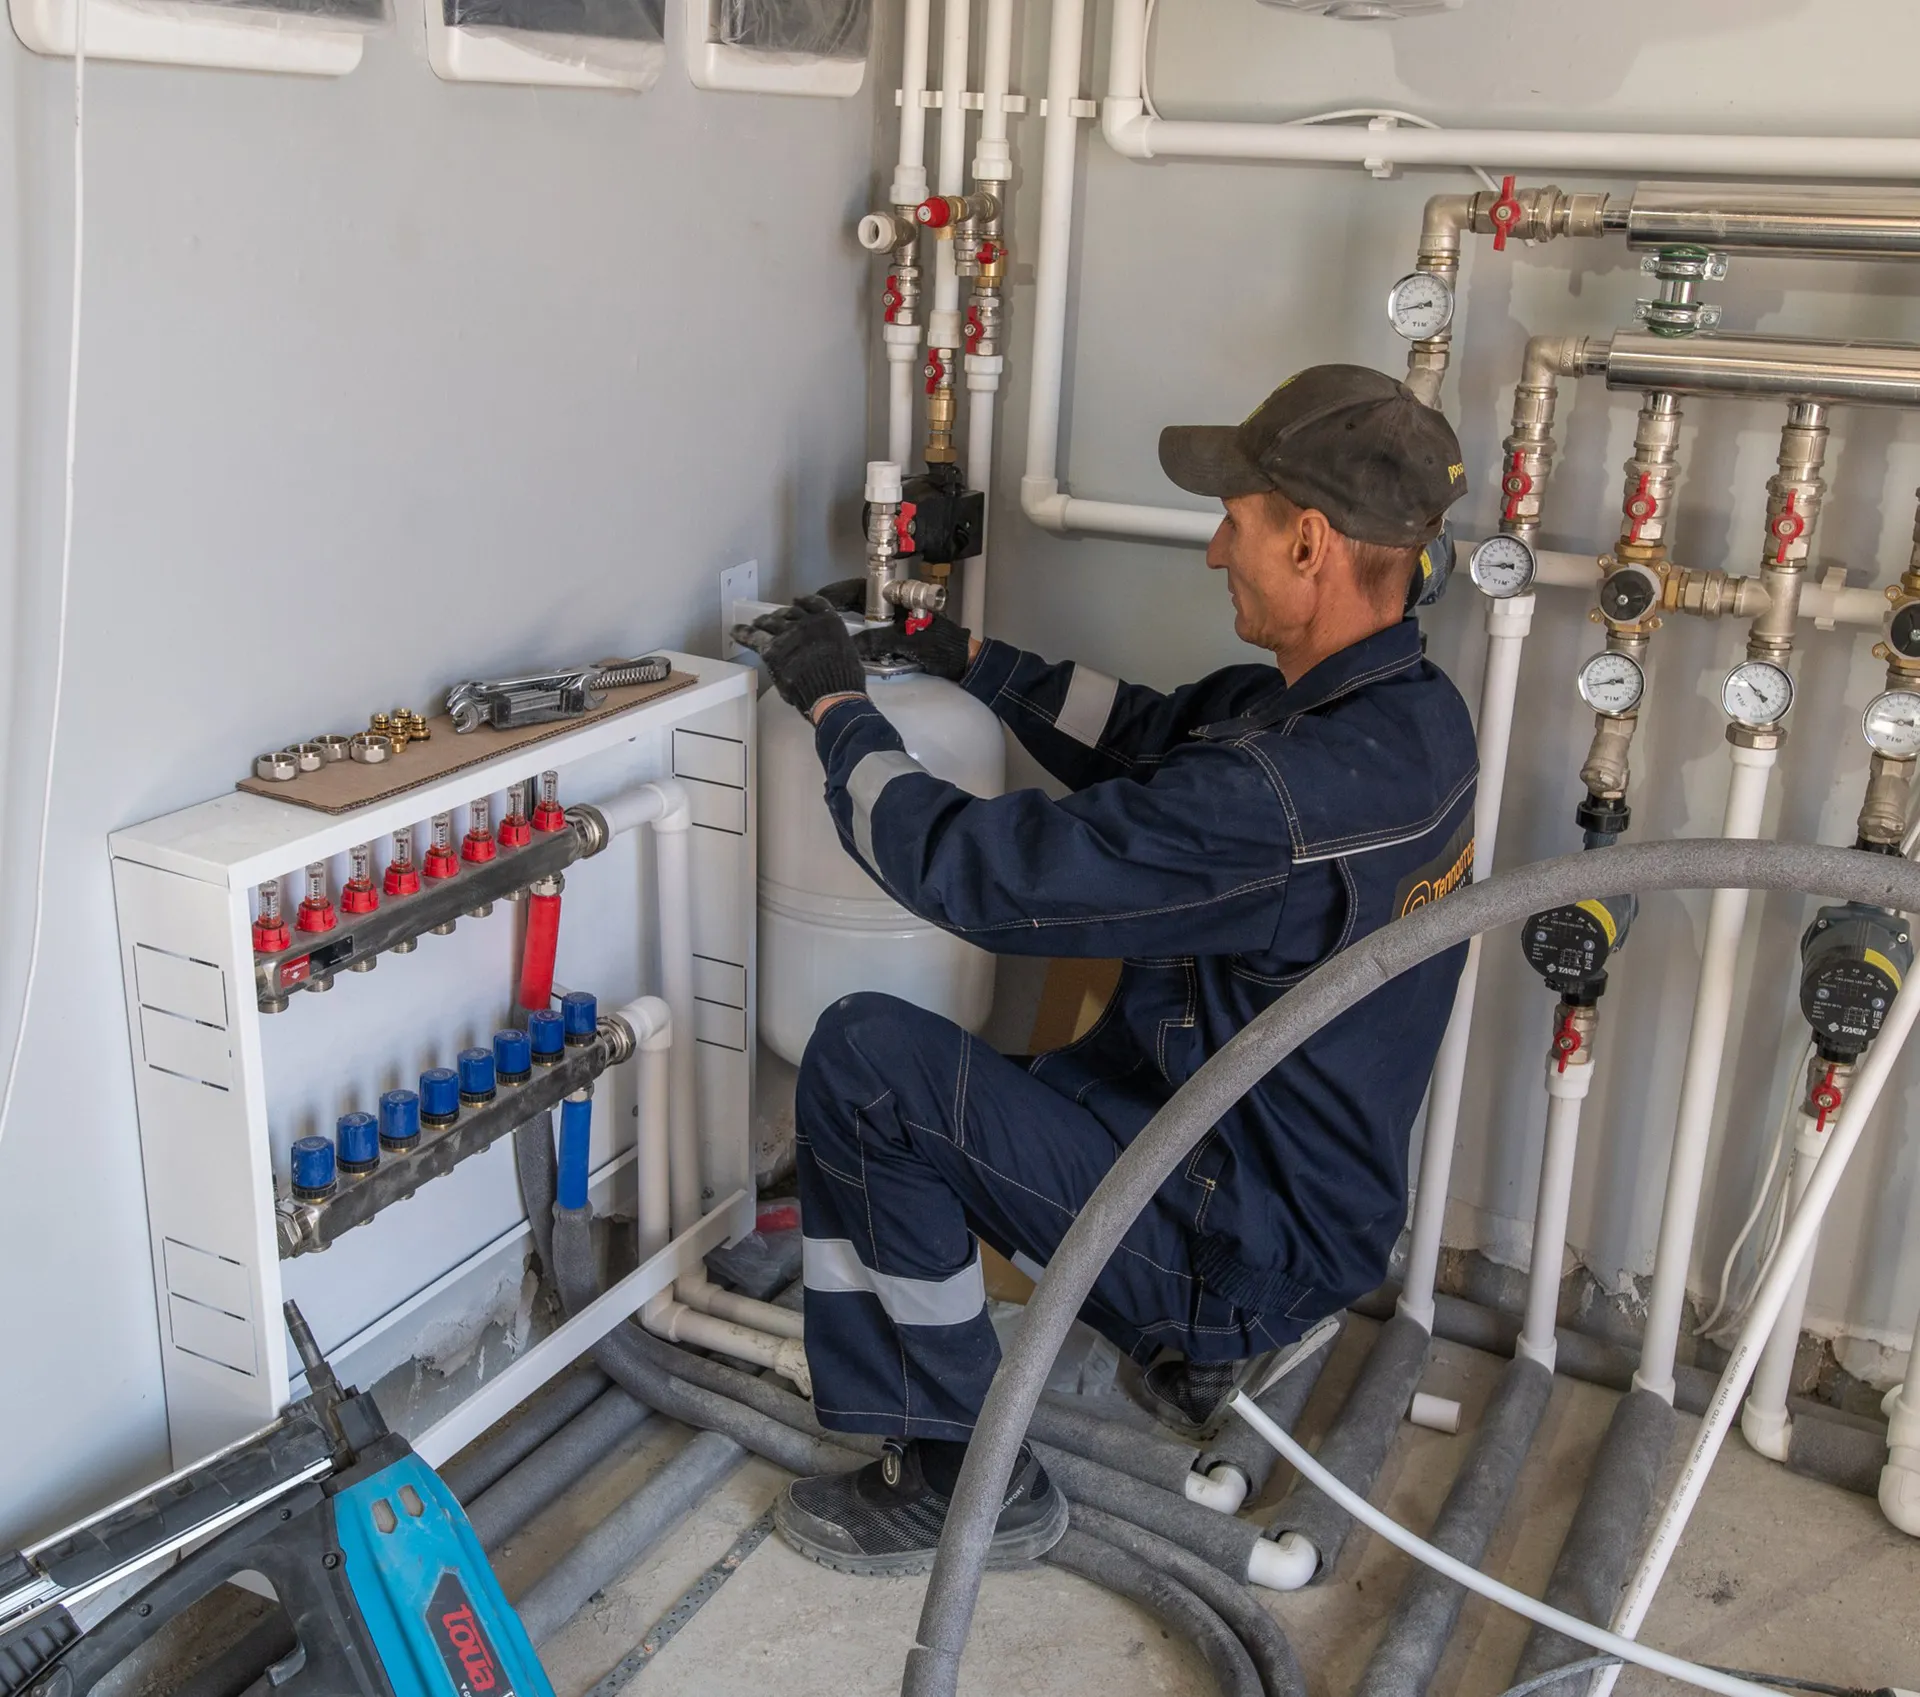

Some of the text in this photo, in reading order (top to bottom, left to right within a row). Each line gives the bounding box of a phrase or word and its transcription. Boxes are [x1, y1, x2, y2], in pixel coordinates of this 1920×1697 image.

[1735, 692, 1746, 707] TIM
[1886, 735, 1902, 743] TIM
[1693, 1431, 1711, 1464] GERMAN
[1708, 1409, 1720, 1427] STD
[1718, 1388, 1729, 1411] DIN
